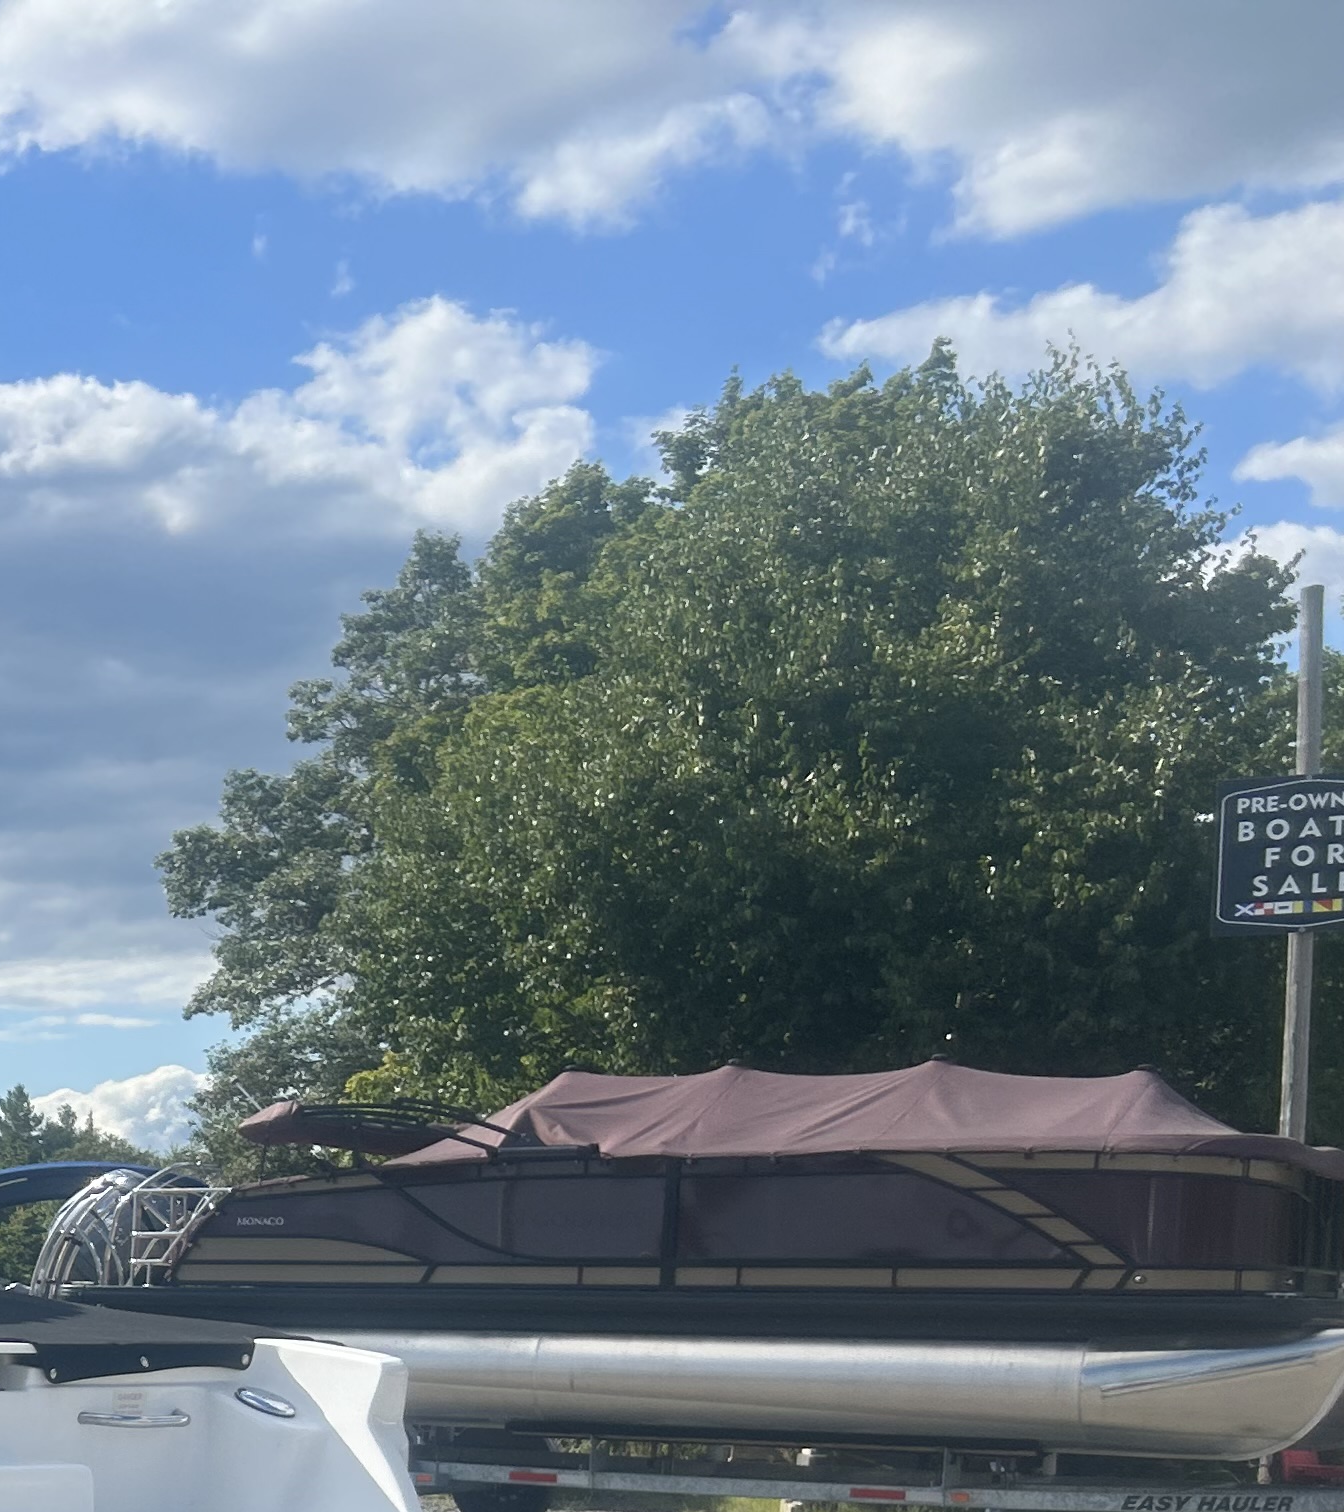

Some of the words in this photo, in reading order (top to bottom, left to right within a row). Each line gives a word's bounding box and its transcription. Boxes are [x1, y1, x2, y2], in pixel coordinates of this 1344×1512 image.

[1265, 843, 1344, 868] FOR
[236, 1216, 285, 1226] MONACO
[1121, 1495, 1192, 1512] EASY
[1197, 1496, 1294, 1512] HAULER
